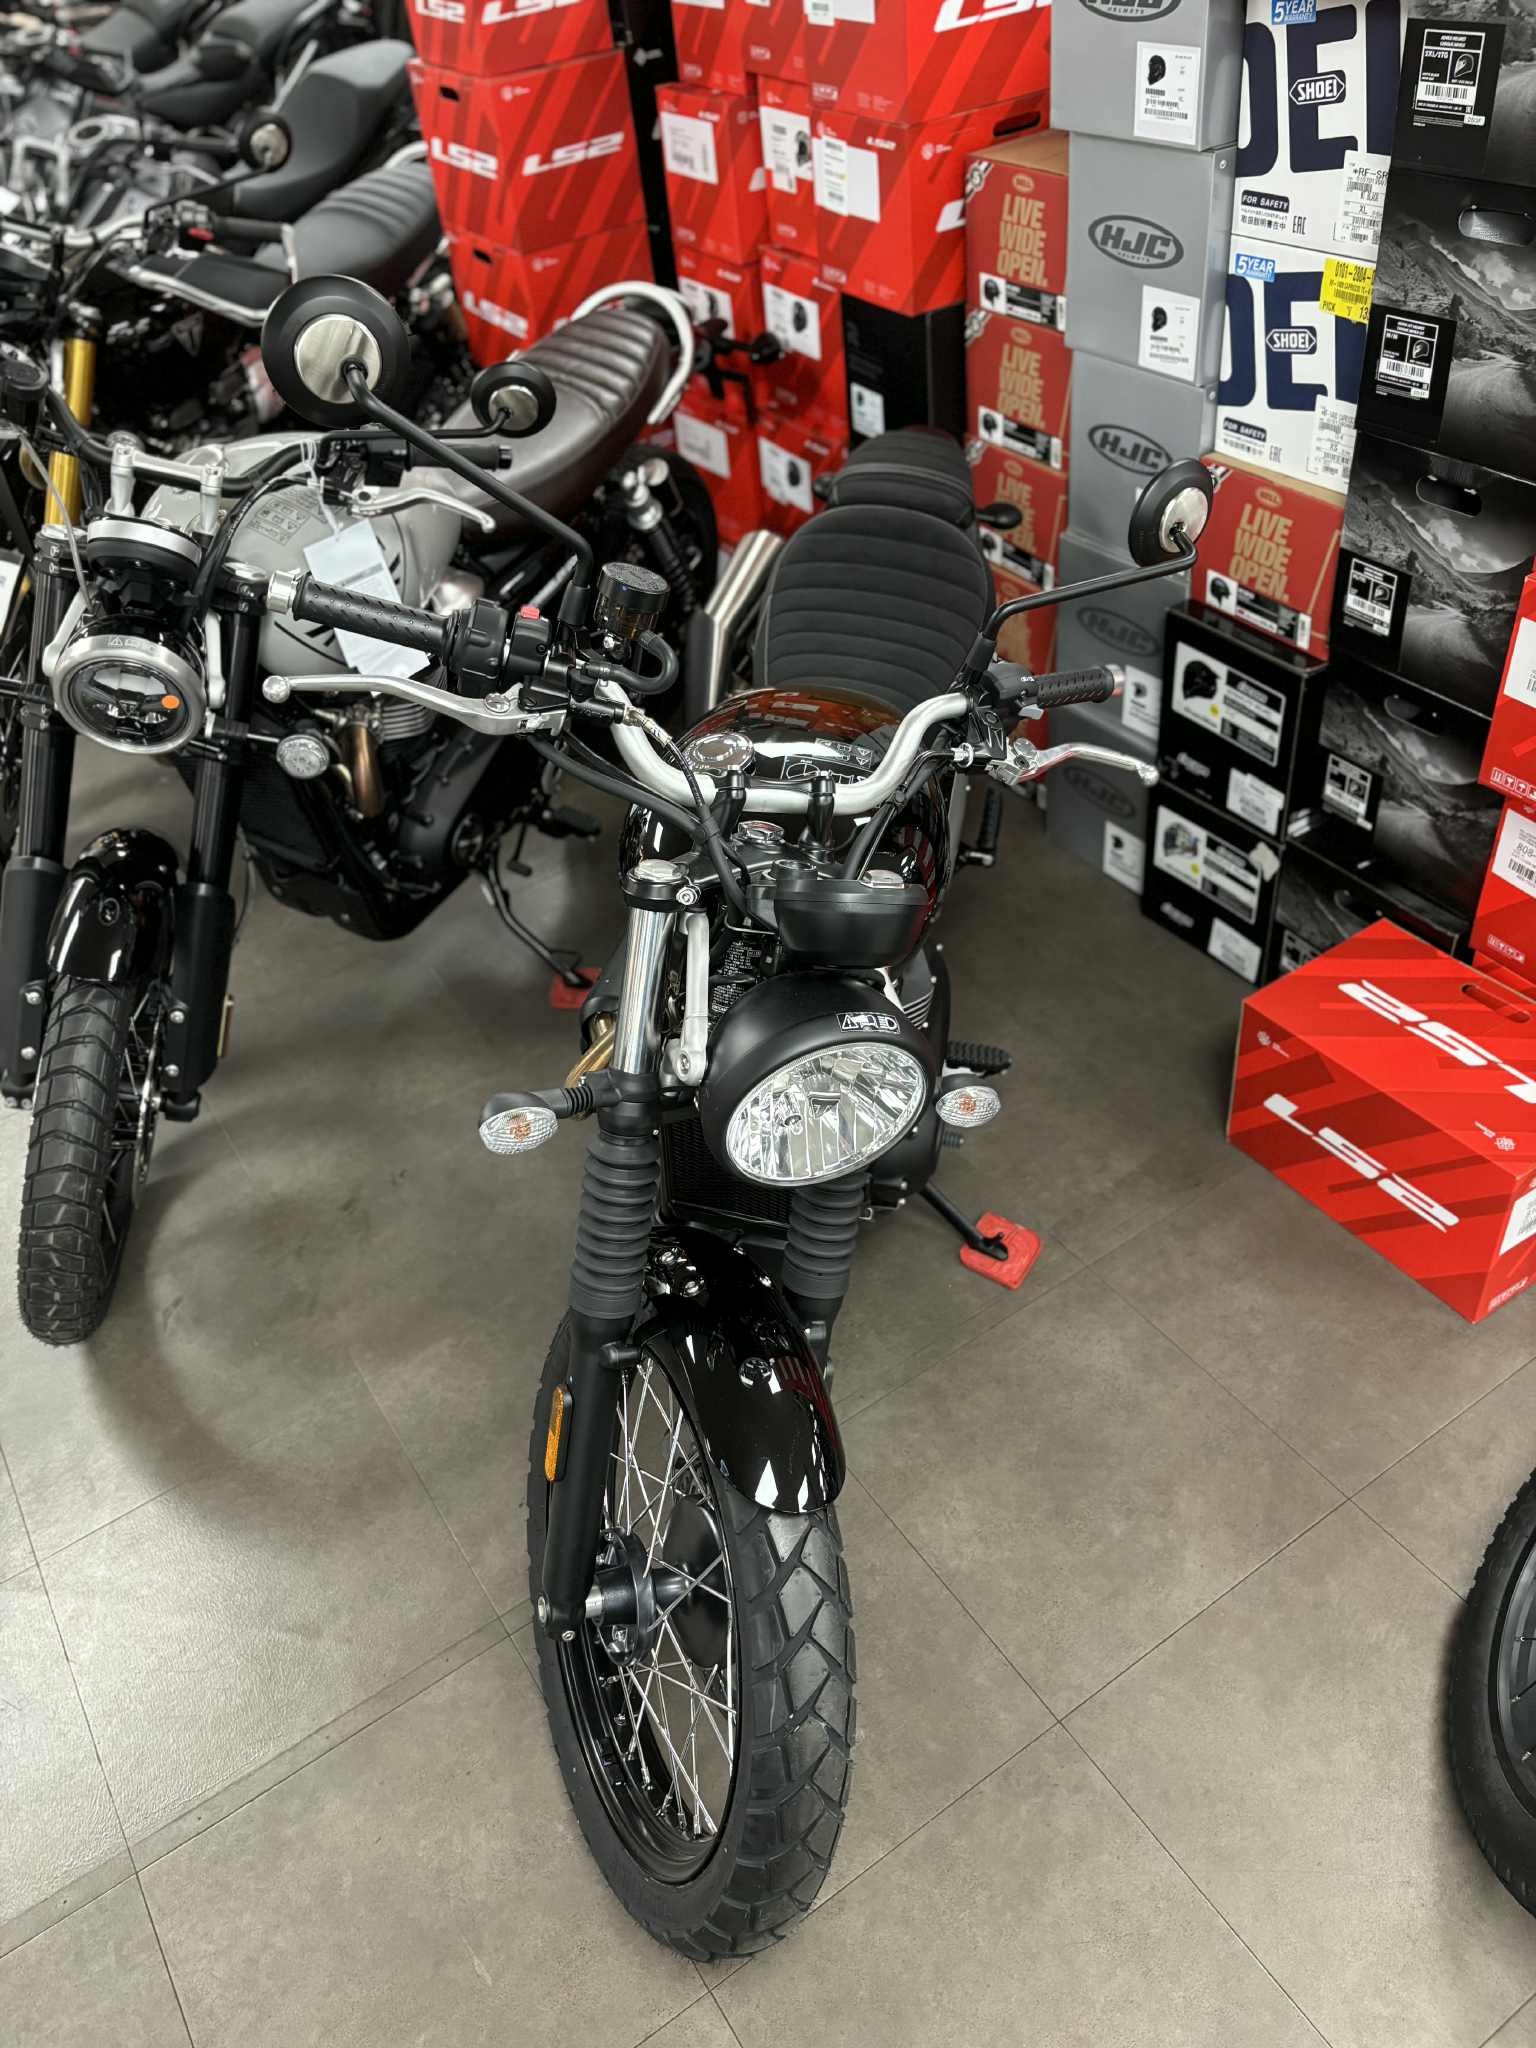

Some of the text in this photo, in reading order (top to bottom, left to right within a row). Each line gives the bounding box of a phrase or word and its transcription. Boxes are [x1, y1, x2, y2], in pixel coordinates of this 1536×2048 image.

[1273, 0, 1313, 23] 5 YEAR
[1297, 79, 1338, 102] SHOEI
[430, 137, 499, 181] LS2
[522, 131, 625, 177] LS2
[1001, 192, 1046, 231] LIVE
[1242, 194, 1288, 210] FOR SAFETY
[999, 219, 1047, 260] WIDE
[1100, 223, 1173, 261] HJC
[996, 248, 1048, 288] OPEN.
[1237, 255, 1274, 275] 5 YEAR
[462, 290, 529, 339] LS2
[1001, 342, 1042, 379] LIVE
[1272, 331, 1310, 350] SHOEI
[999, 366, 1044, 401] WIDE
[997, 390, 1046, 430] OPEN.
[1224, 420, 1239, 431] FOR
[1240, 425, 1265, 440] SAFETY
[1099, 430, 1162, 474] HJC
[1239, 502, 1294, 545] LIVE
[1233, 526, 1293, 574] WIDE
[1228, 553, 1290, 603] OPEN.
[1263, 1092, 1461, 1233] LS2
